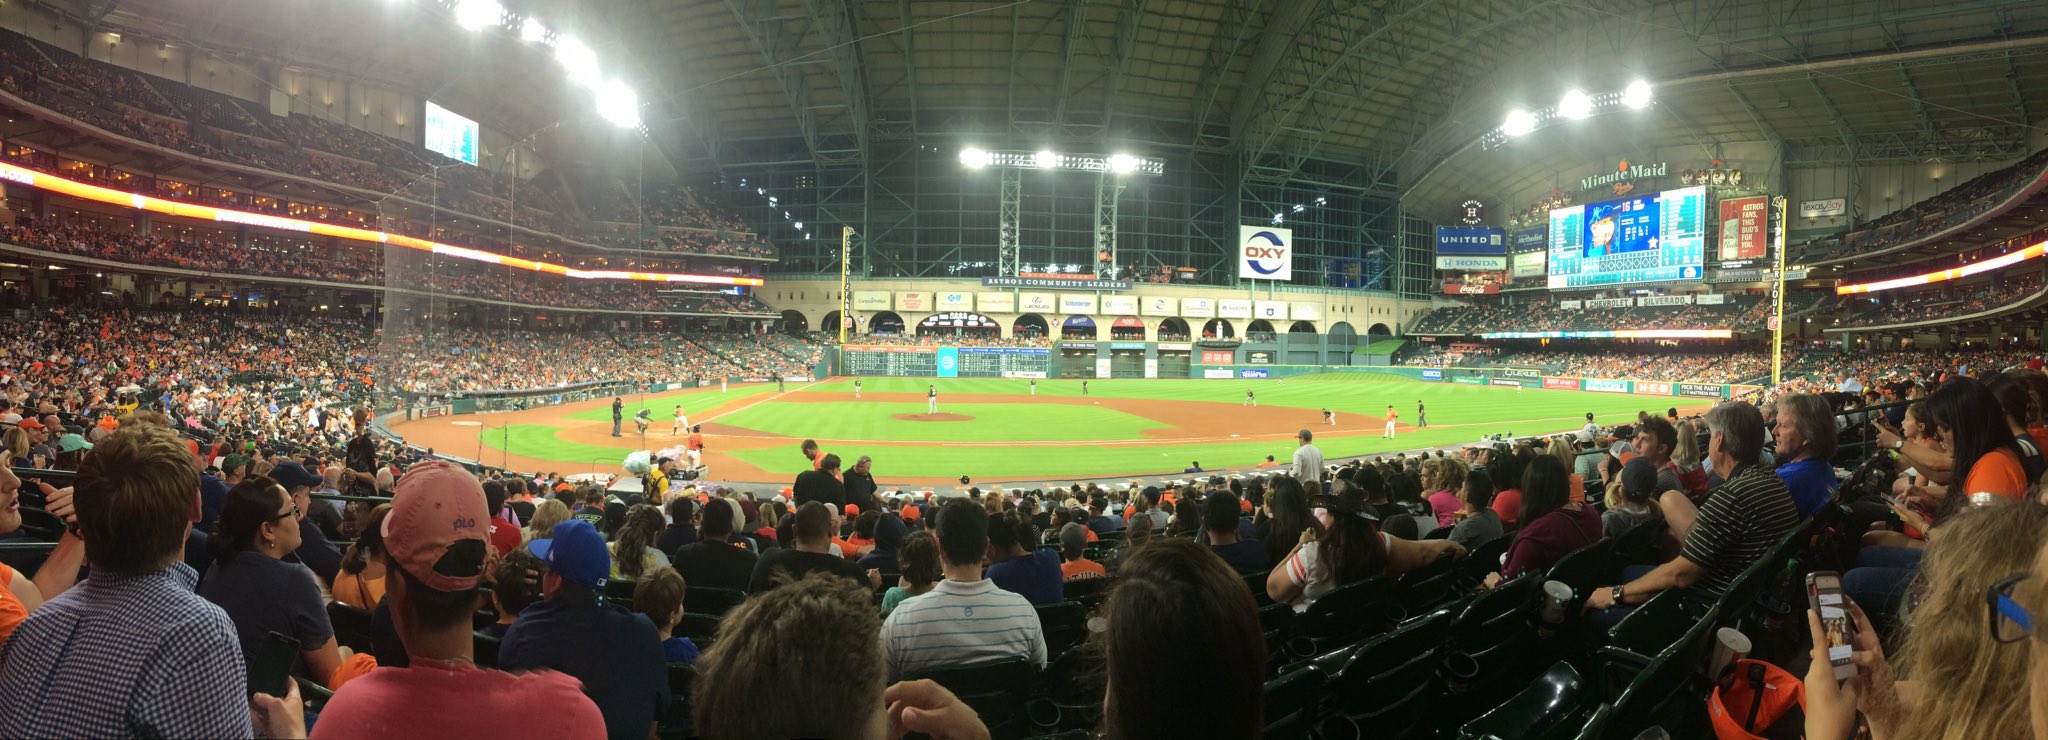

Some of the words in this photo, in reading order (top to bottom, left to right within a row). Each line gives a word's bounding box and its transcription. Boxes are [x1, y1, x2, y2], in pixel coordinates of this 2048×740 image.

[1580, 169, 1628, 192] Minute
[1630, 162, 1667, 179] Maid
[1622, 201, 1631, 212] 16
[1742, 203, 1765, 212] ASTROS
[1802, 202, 1825, 212] Texas
[1826, 200, 1843, 211] Bay
[1467, 207, 1477, 217] H
[1742, 211, 1758, 219] FANS,
[1741, 226, 1759, 234] BUD'S
[1741, 241, 1754, 249] YOU.
[1245, 246, 1286, 260] OXY
[1026, 279, 1083, 287] COMMUNITY
[1589, 299, 1629, 308] CHEVROLET
[1643, 296, 1685, 306] SILVERADO
